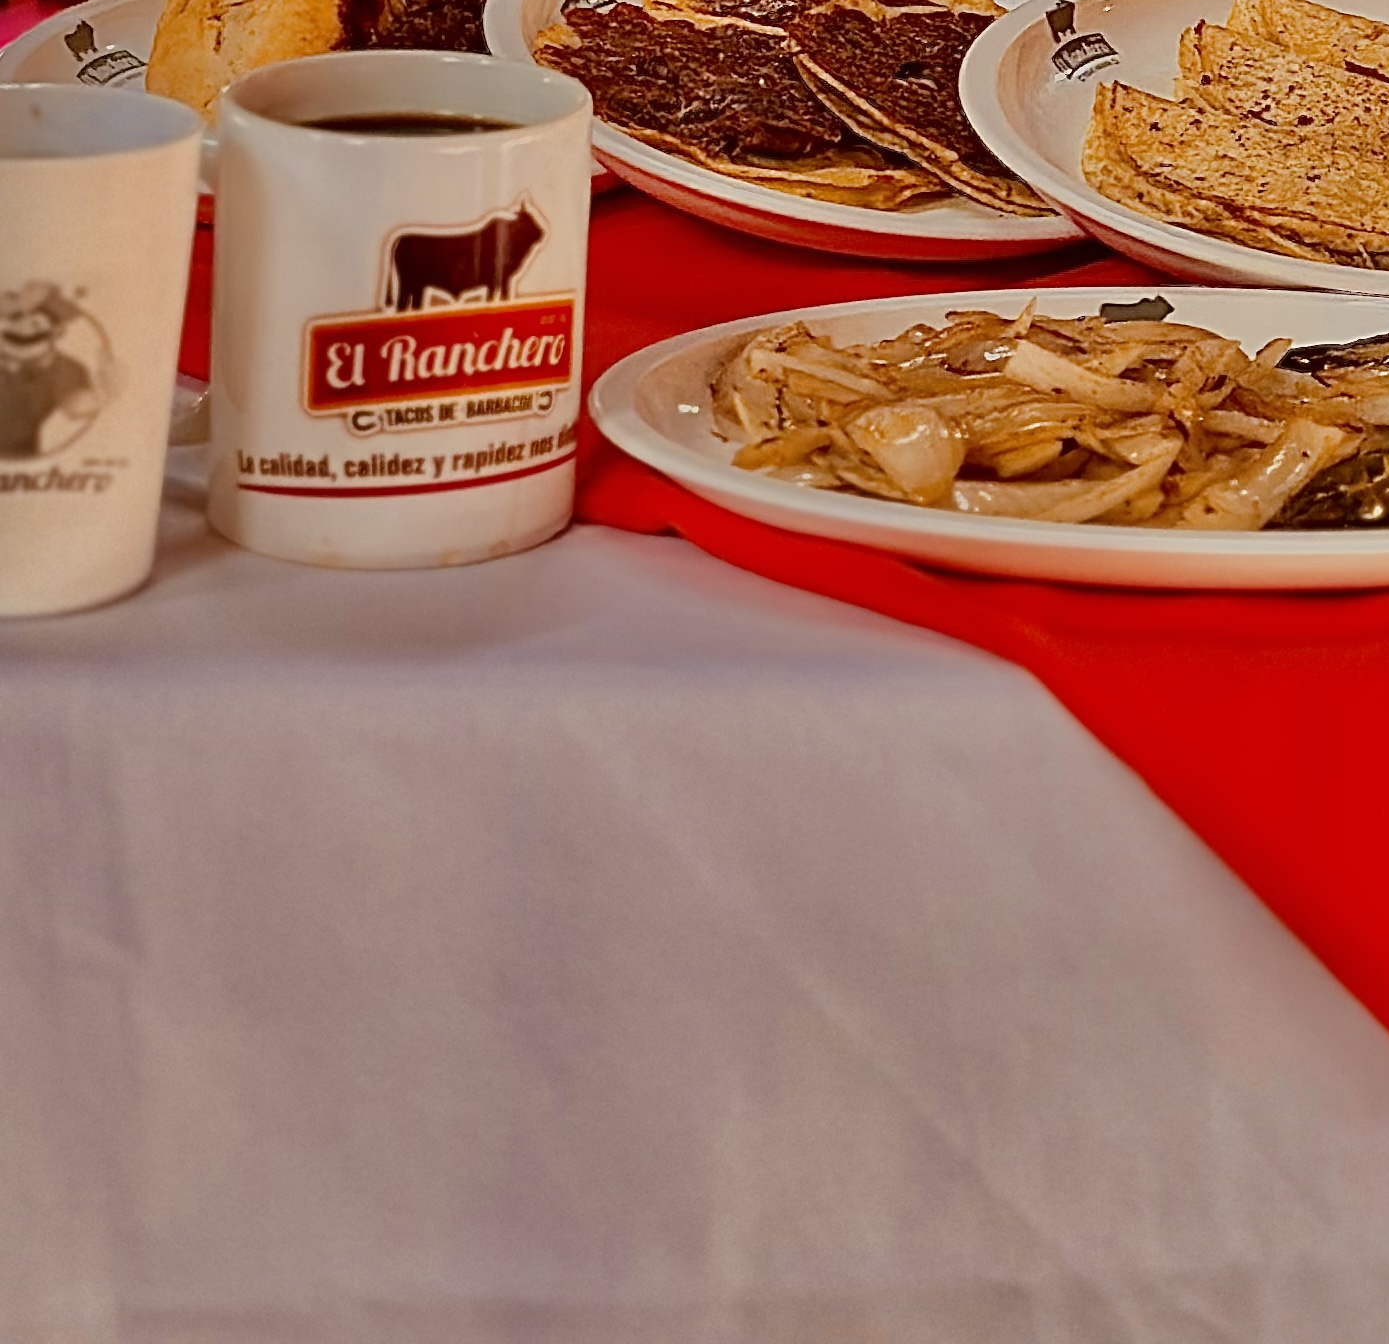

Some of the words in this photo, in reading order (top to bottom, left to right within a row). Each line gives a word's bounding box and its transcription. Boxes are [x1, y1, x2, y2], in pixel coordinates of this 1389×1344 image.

[326, 342, 366, 389] El
[380, 327, 567, 383] Ranchero
[385, 404, 434, 426] TACOS
[438, 401, 458, 422] DE
[260, 452, 337, 483] calidad,
[343, 452, 426, 478] calidez
[433, 454, 447, 478] y
[452, 441, 526, 475] rapidez
[530, 435, 554, 458] nos
